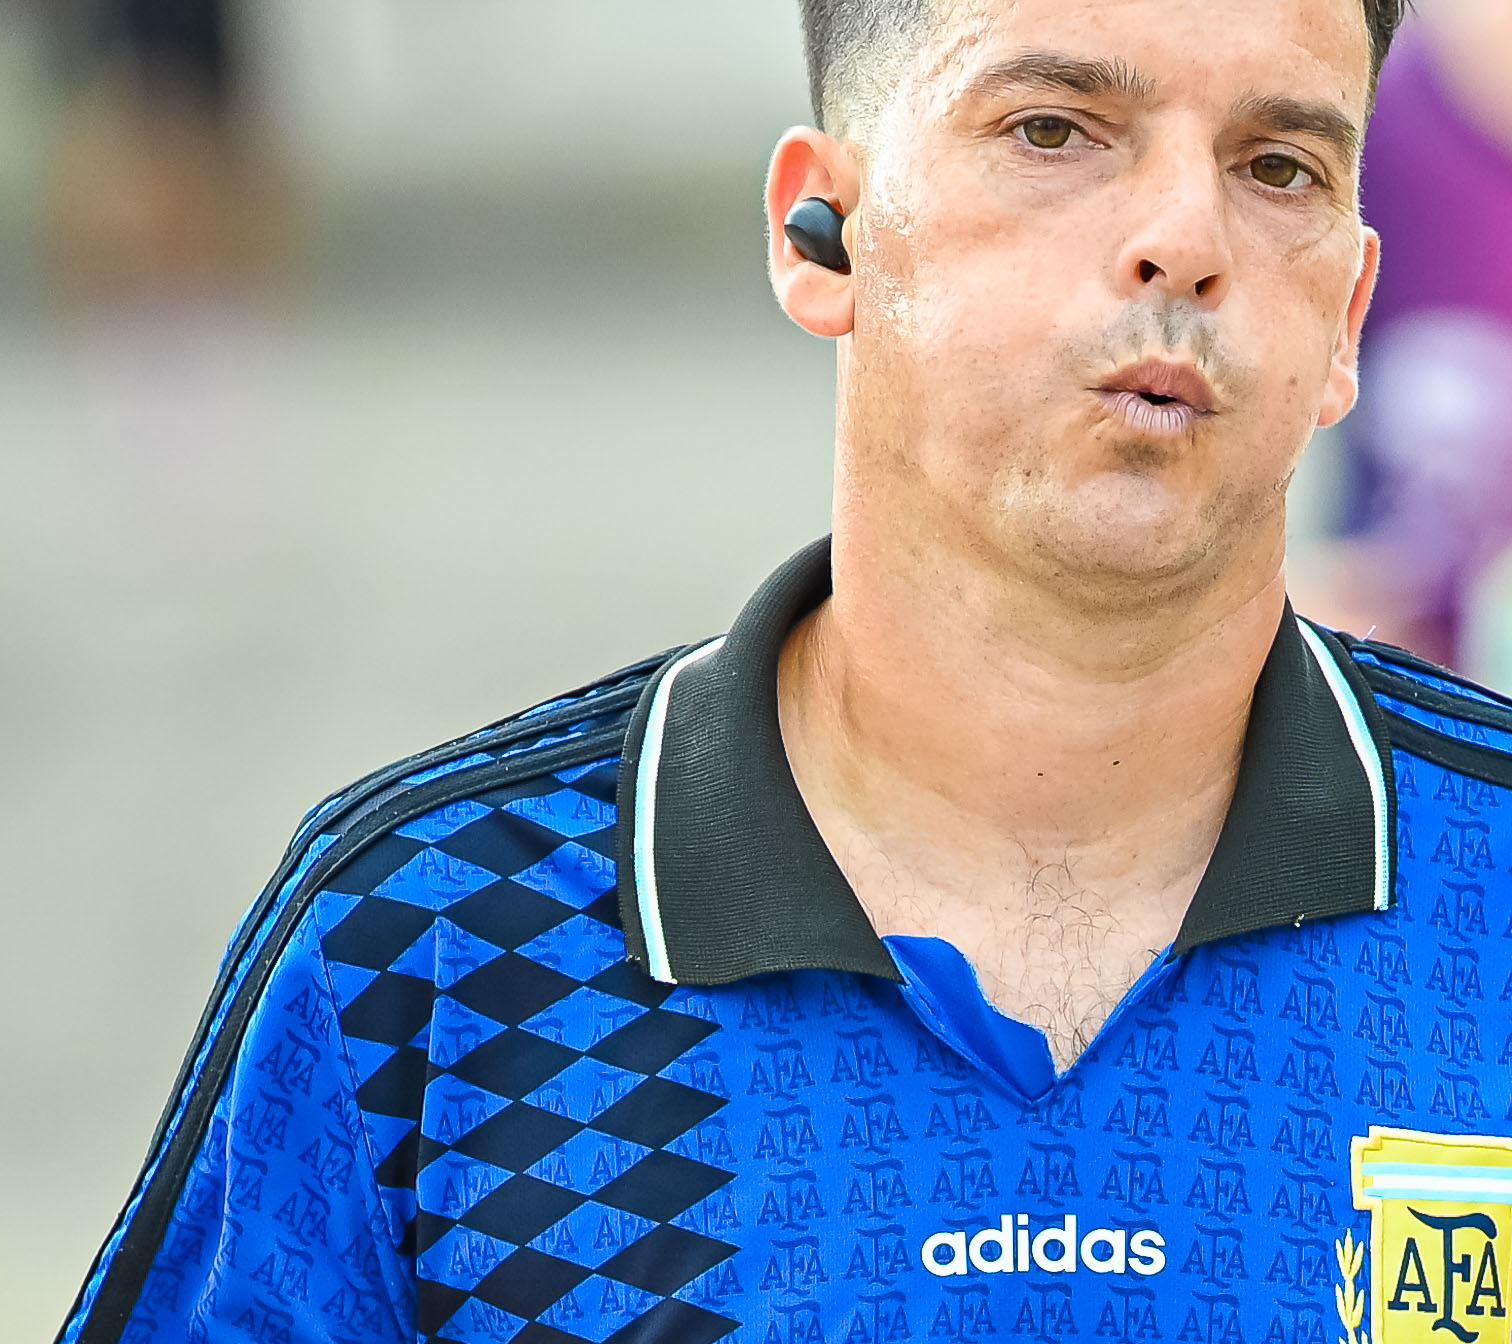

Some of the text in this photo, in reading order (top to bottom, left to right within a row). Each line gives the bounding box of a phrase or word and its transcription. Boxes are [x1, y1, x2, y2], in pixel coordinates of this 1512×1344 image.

[1433, 820, 1493, 874] AFA
[1429, 876, 1489, 944] AFA
[1280, 971, 1340, 1039] AFA
[1425, 941, 1485, 1009] AFA
[1356, 993, 1409, 1052] AFA
[1427, 1008, 1480, 1067] AFA
[256, 1032, 321, 1093] AFA
[747, 1038, 815, 1101] AFA
[1199, 1023, 1259, 1091] AFA
[1278, 1037, 1338, 1105] AFA
[1354, 1058, 1414, 1117] AFA
[839, 1092, 907, 1155] AFA
[1104, 1083, 1173, 1147] AFA
[1188, 1089, 1257, 1158] AFA
[1427, 1072, 1487, 1126] AFA
[754, 1104, 822, 1167] AFA
[1269, 1102, 1338, 1171] AFA
[759, 1169, 827, 1232] AFA
[845, 1158, 913, 1221] AFA
[929, 1148, 998, 1211] AFA
[1013, 1142, 1082, 1206] AFA
[1098, 1150, 1167, 1214] AFA
[1183, 1159, 1252, 1223] AFA
[1268, 1171, 1337, 1231] AFA
[843, 1224, 912, 1287] AFA
[921, 1213, 1166, 1276] adidas
[1180, 1225, 1249, 1289] AFA
[1388, 1206, 1506, 1344] AFA
